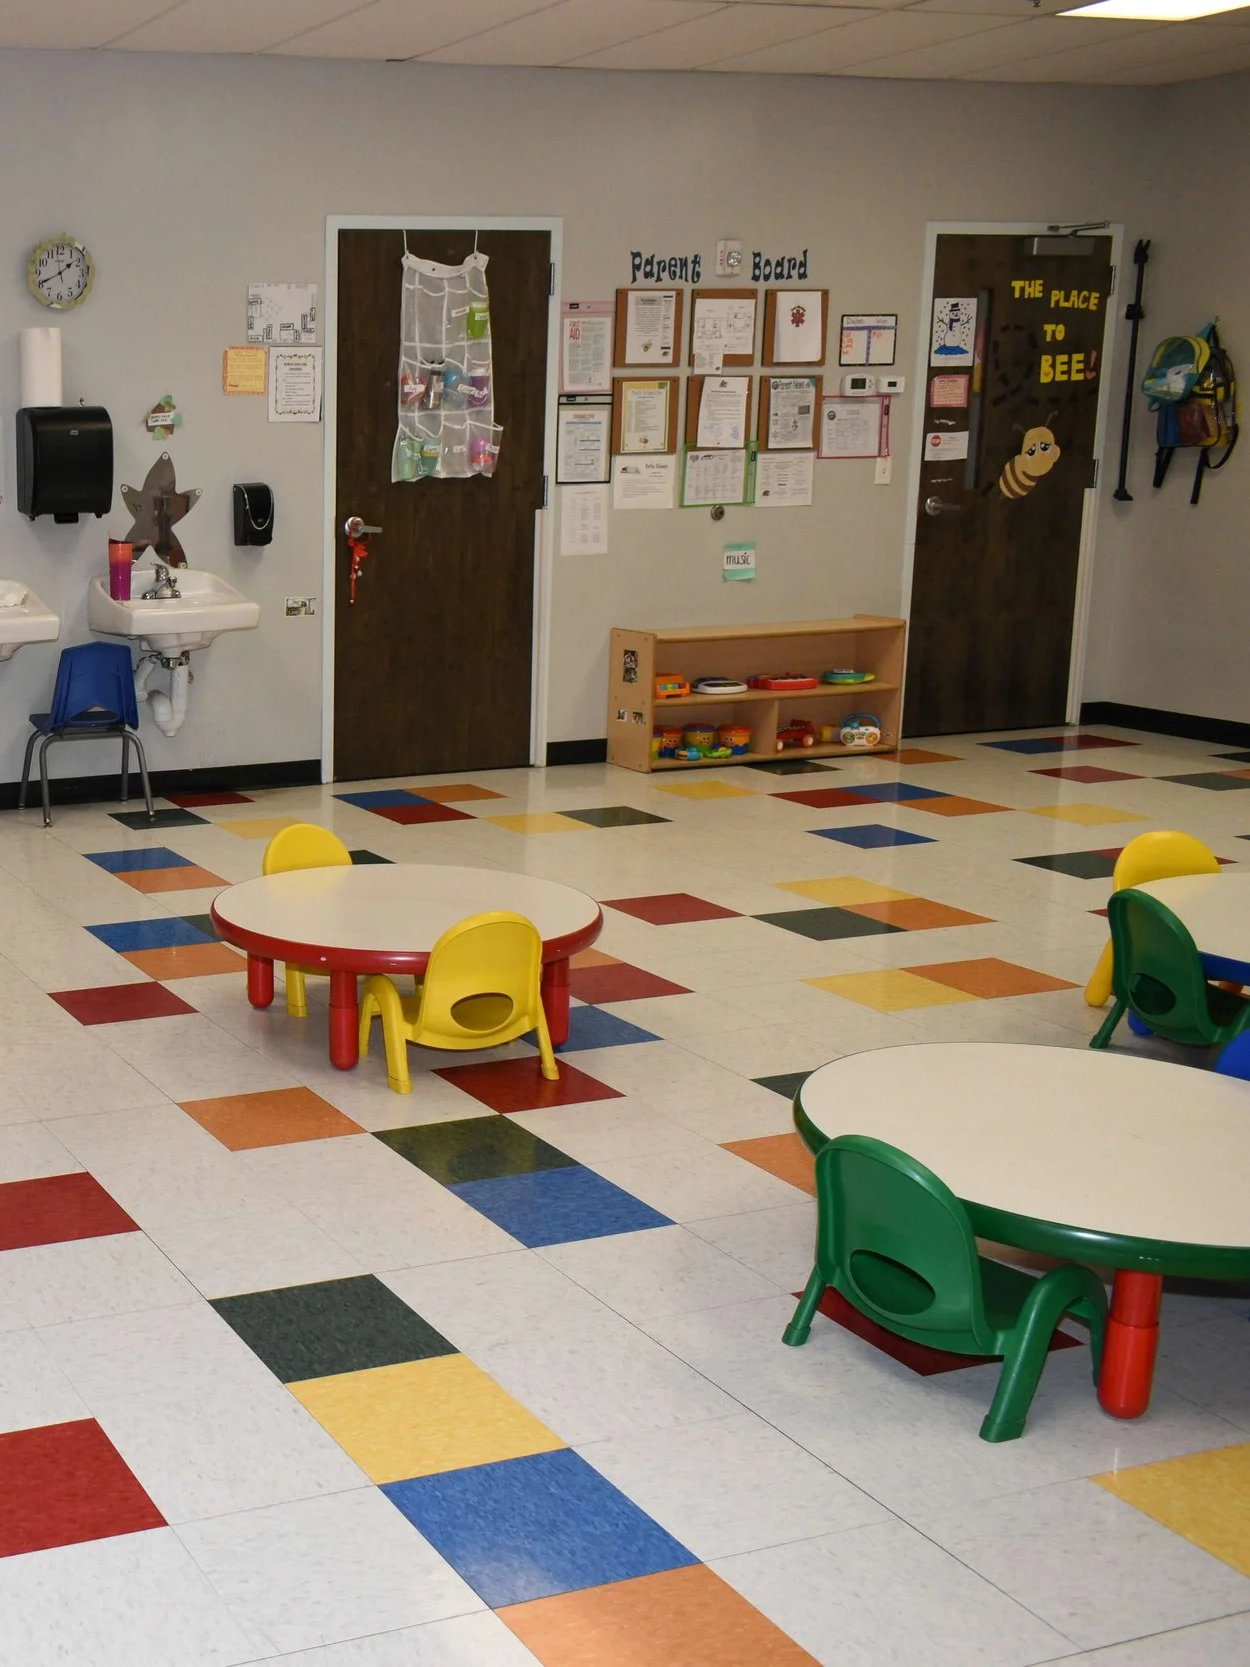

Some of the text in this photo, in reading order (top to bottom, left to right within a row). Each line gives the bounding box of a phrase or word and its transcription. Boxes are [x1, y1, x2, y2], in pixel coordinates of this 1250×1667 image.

[47, 249, 54, 259] 11
[56, 245, 65, 255] 12
[38, 258, 81, 267] 10 2
[630, 248, 809, 284] Parent Board
[79, 268, 85, 277] 3
[75, 279, 81, 288] 4
[47, 287, 73, 296] 7 5
[56, 291, 63, 301] 6
[1011, 280, 1100, 311] THE PLACE
[1043, 324, 1065, 341] TO
[1040, 350, 1097, 383] BEE!
[726, 552, 750, 565] music
